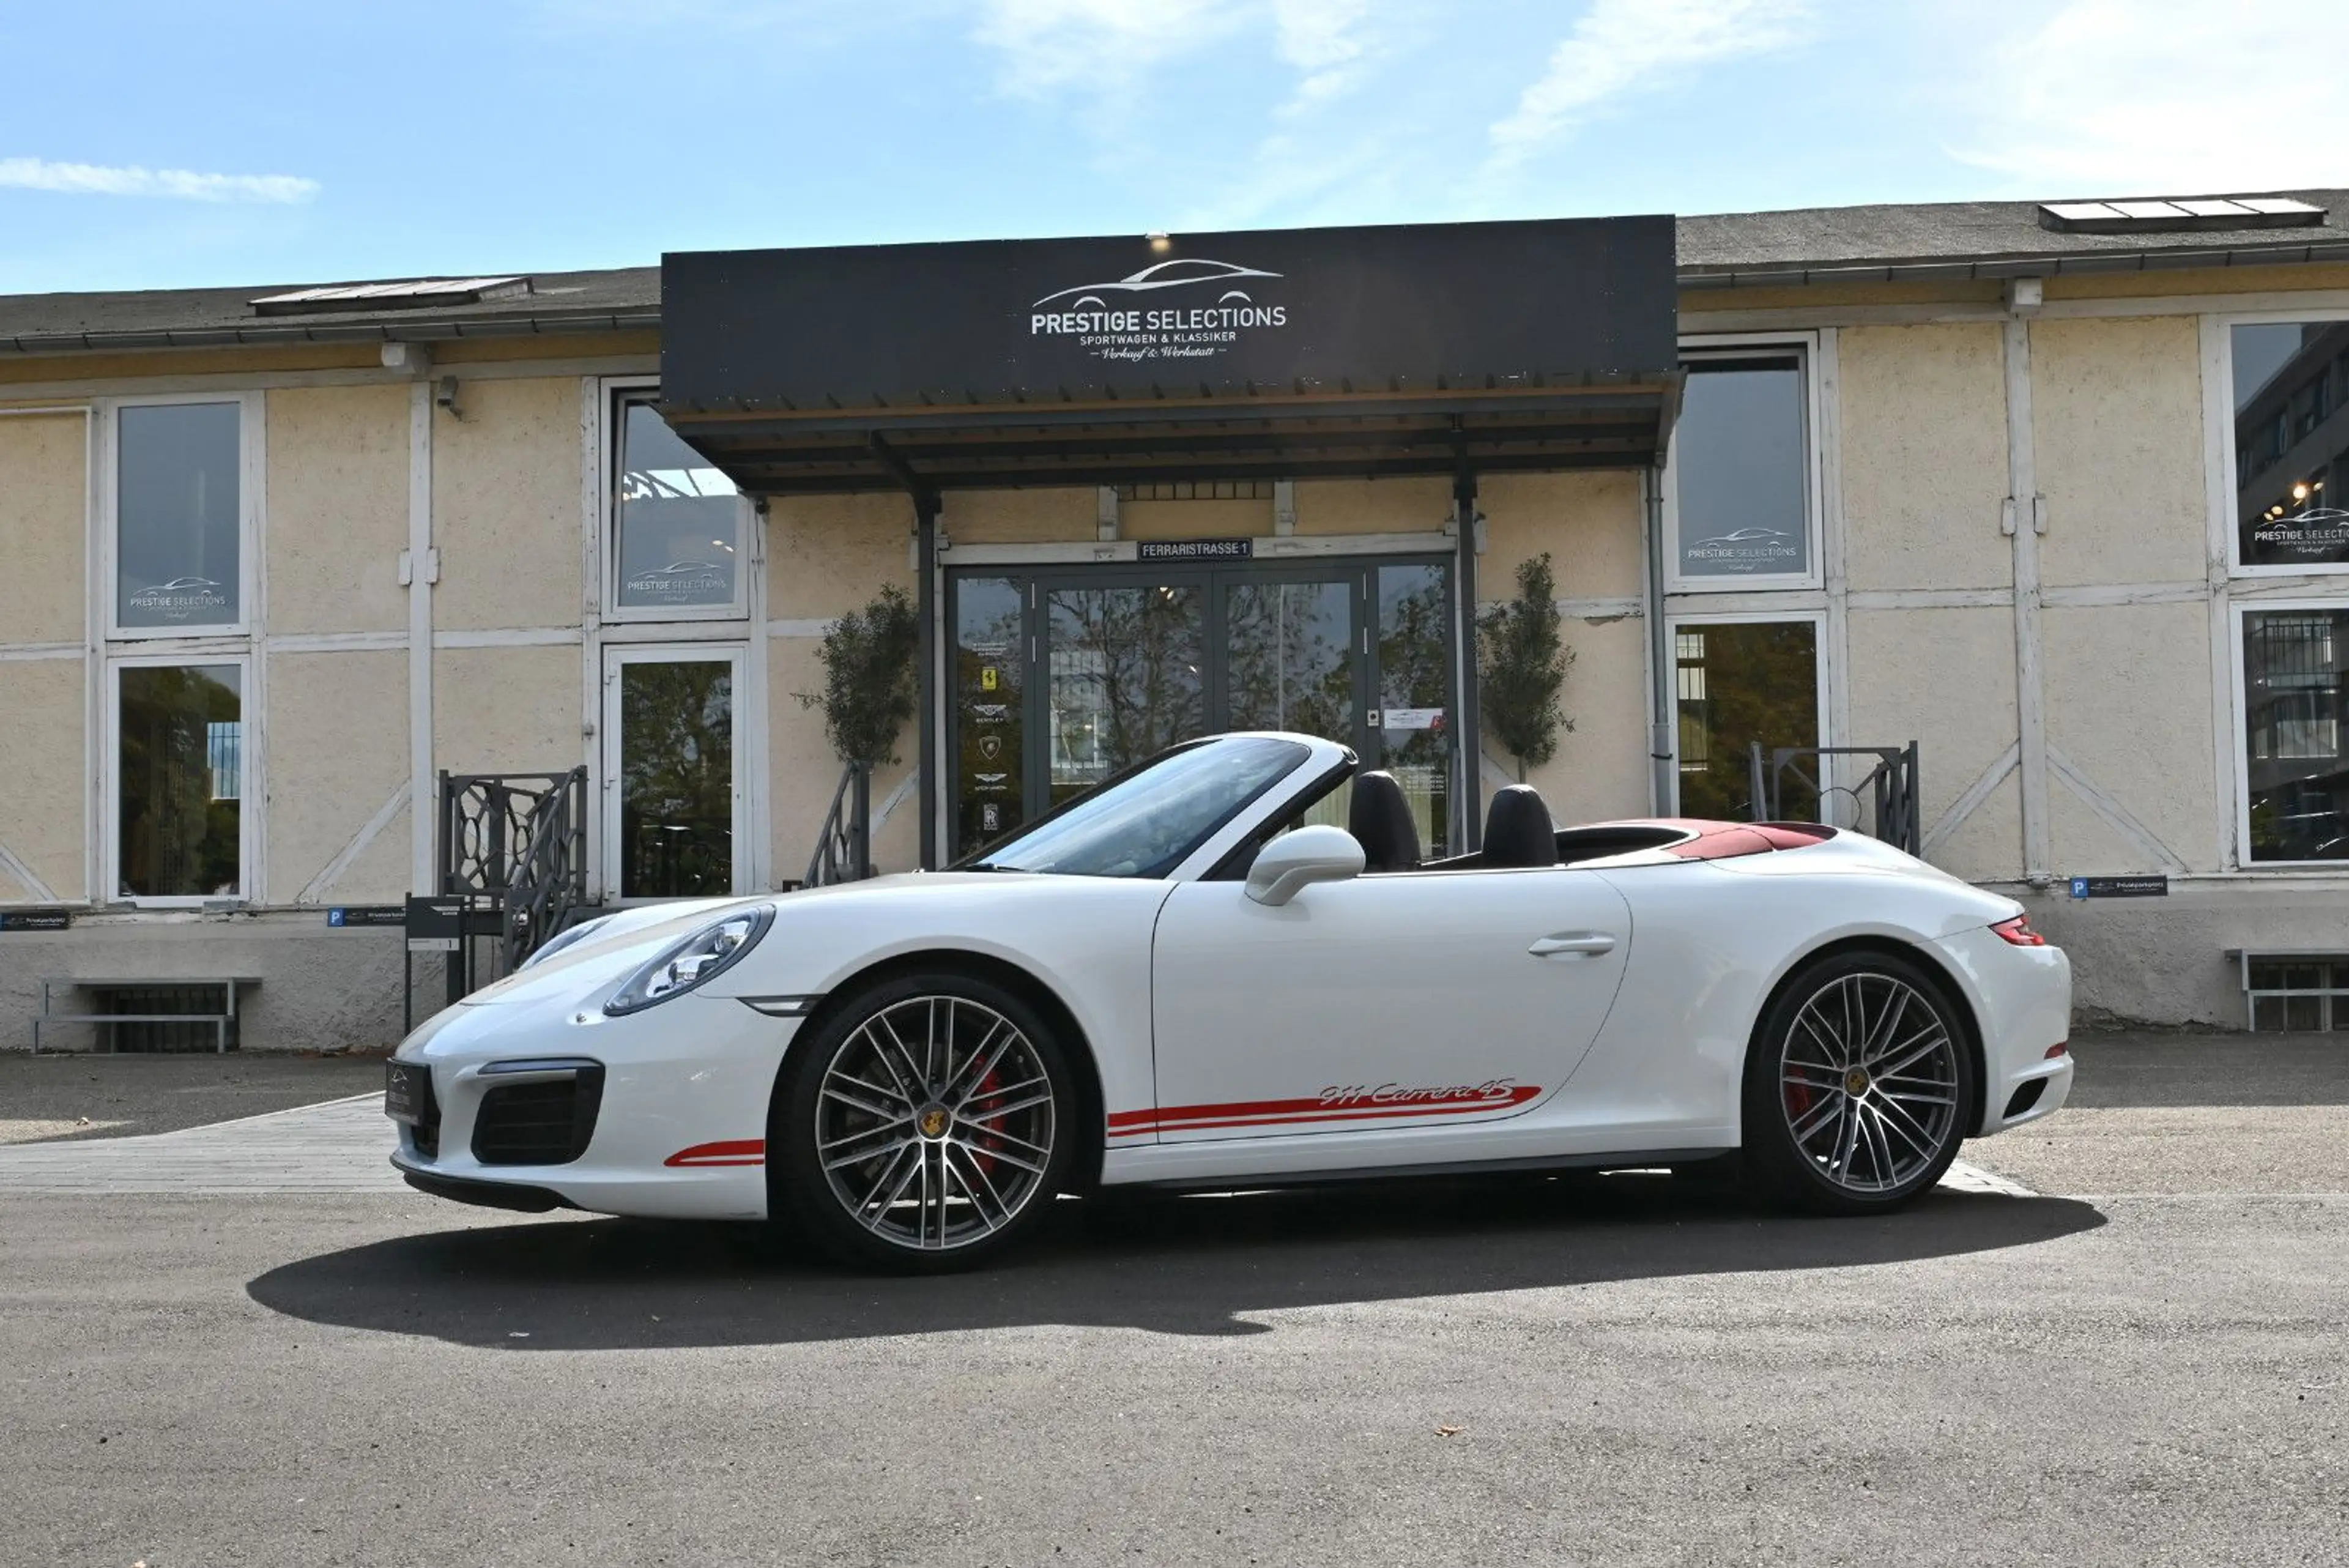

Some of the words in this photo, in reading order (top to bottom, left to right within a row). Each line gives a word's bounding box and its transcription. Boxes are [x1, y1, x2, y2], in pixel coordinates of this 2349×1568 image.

[1031, 311, 1141, 335] PRESTIGE
[1146, 306, 1286, 330] SELECTIONS
[1080, 334, 1157, 346] SPORTWAGEN
[1161, 333, 1169, 343] &
[1173, 331, 1236, 343] KLASSIKER
[1101, 346, 1151, 362] Verkauf
[1148, 348, 1159, 358] &
[1160, 345, 1214, 357] Werkstatt
[2255, 531, 2303, 541] PRESTIGE
[1142, 542, 1239, 557] FERRARISTRASSE
[1241, 543, 1247, 554] 1
[1688, 549, 1735, 559] PRESTIGE
[1737, 548, 1797, 558] SELECTIONS
[627, 581, 670, 590] PRESTIGE
[130, 597, 171, 606] PRESTIGE
[173, 596, 226, 606] SELECTIONS
[2074, 882, 2084, 894] P
[331, 912, 340, 923] P
[1319, 1085, 1365, 1106] 911
[1371, 1082, 1471, 1102] Carrera
